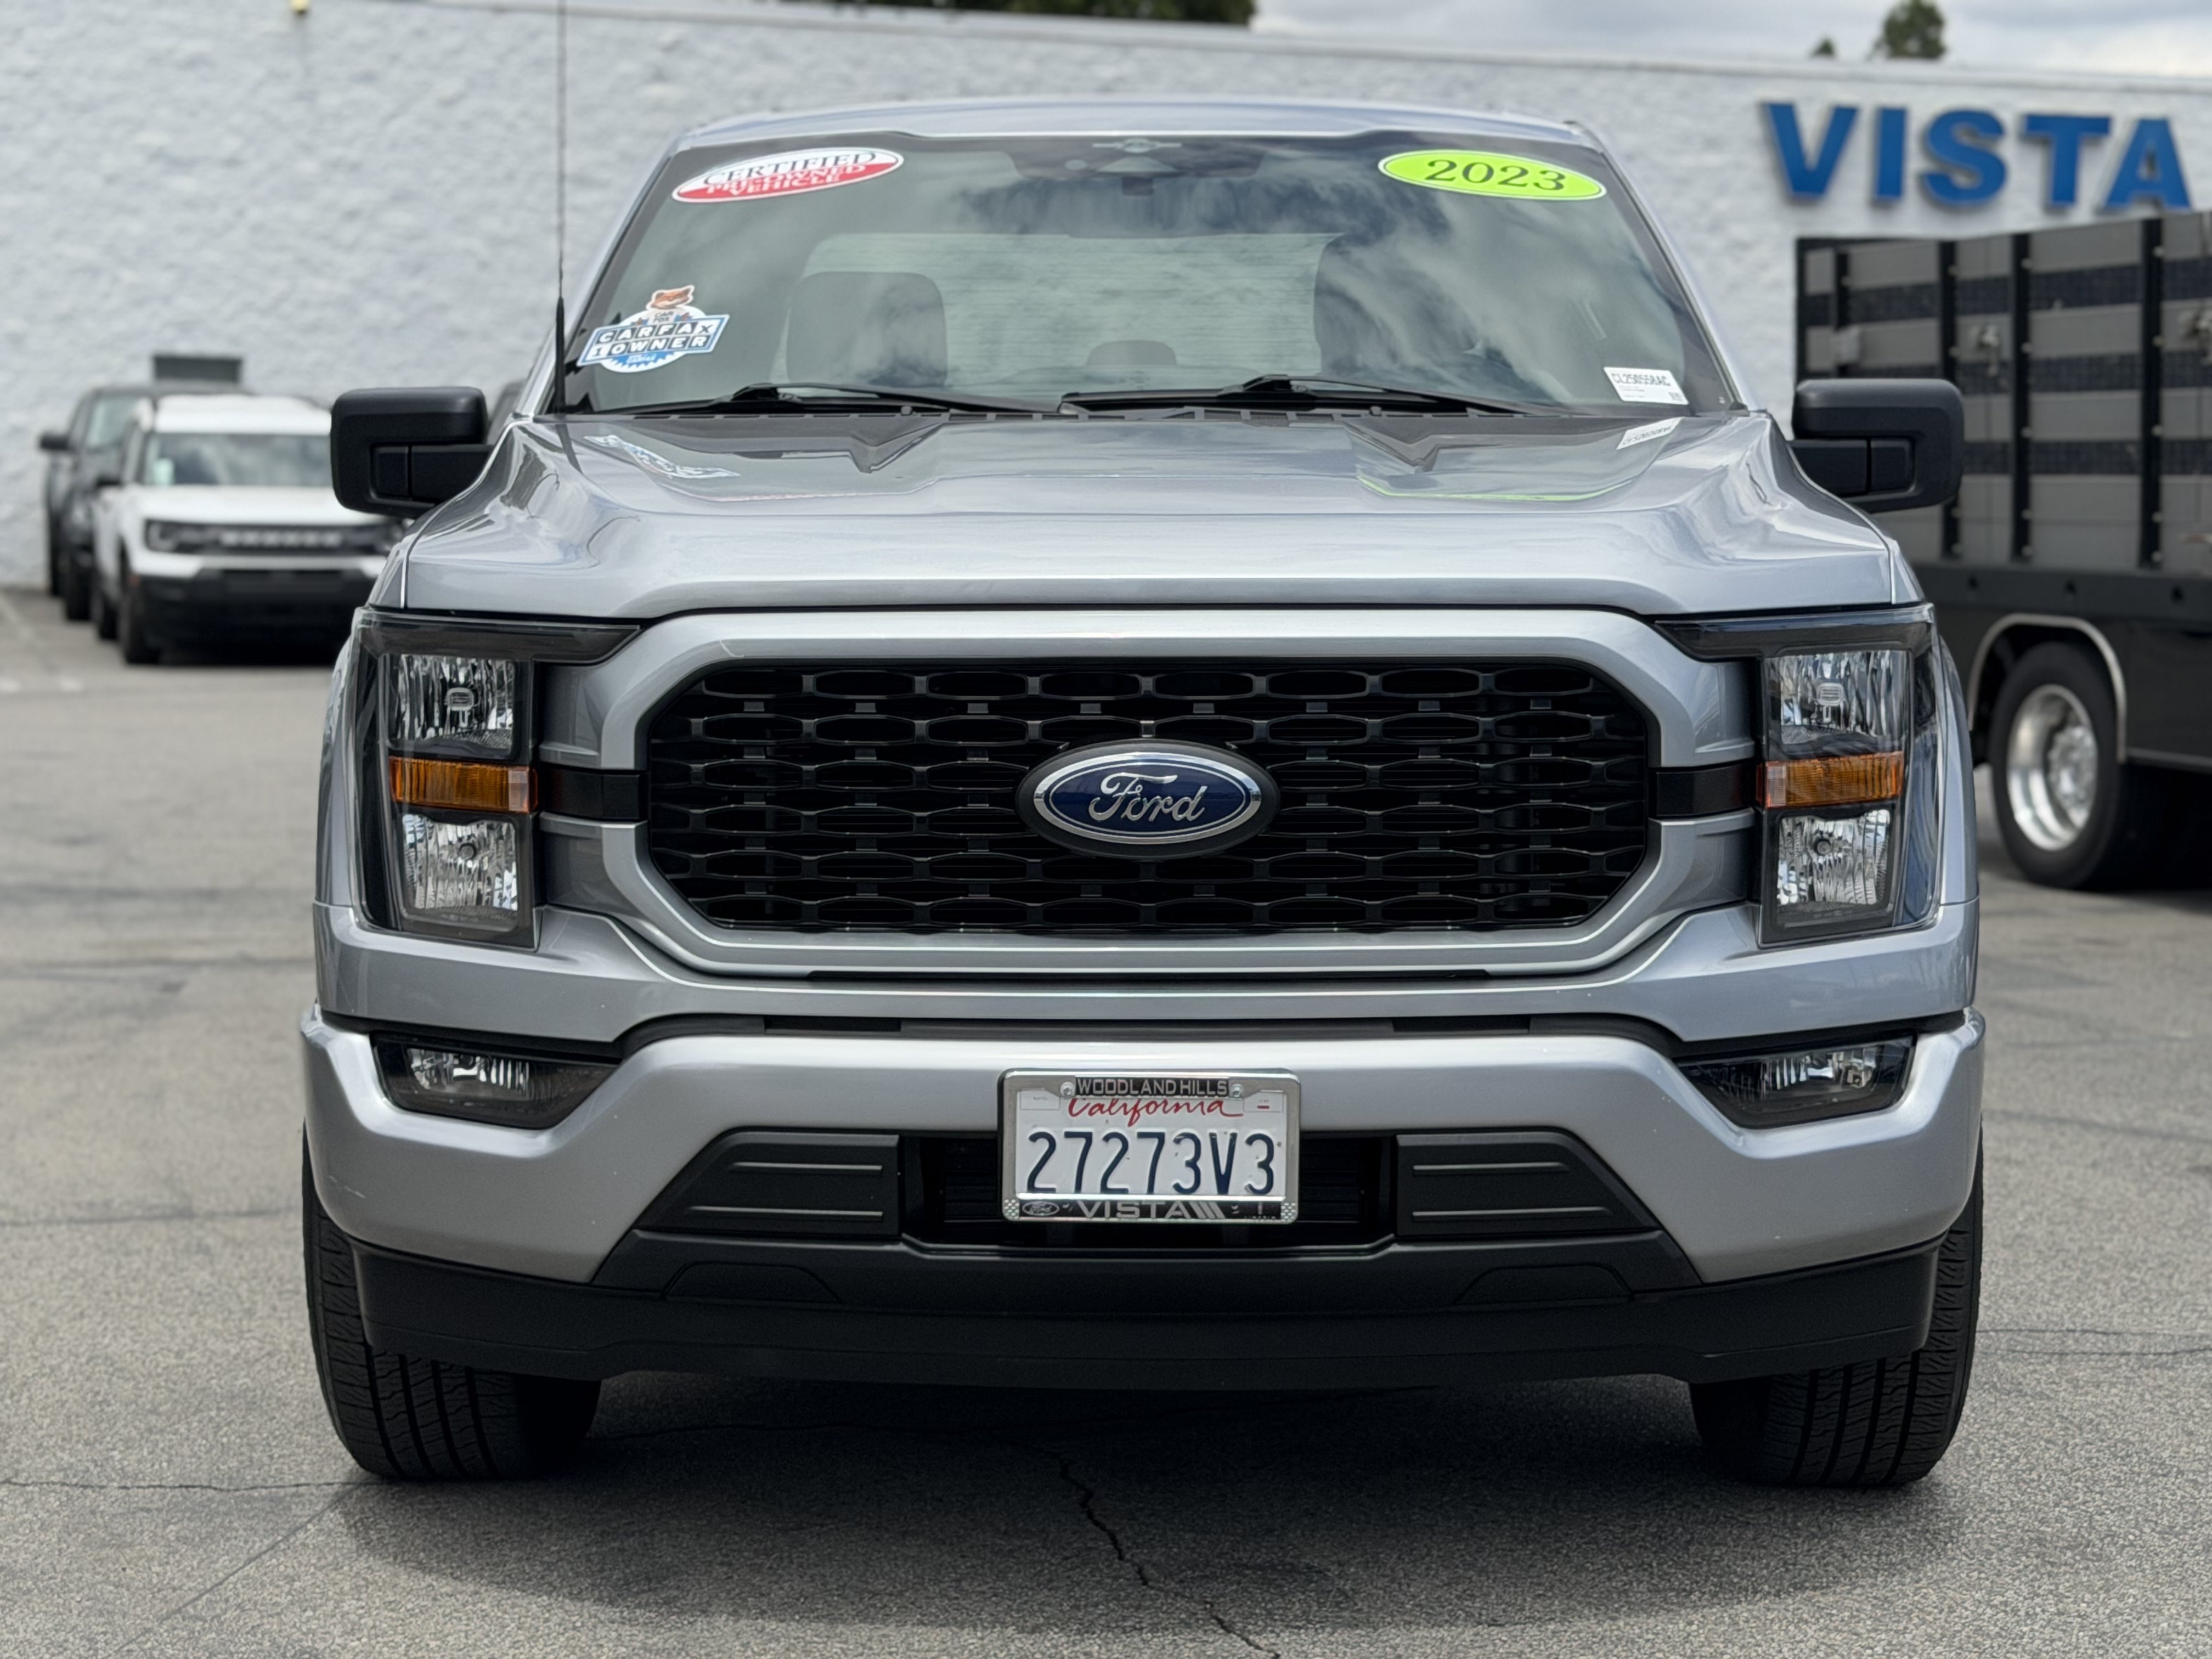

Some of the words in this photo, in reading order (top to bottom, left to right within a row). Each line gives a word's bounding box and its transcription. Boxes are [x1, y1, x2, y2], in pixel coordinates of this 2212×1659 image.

[703, 153, 876, 185] CERTIFIED
[1762, 103, 2192, 209] VISTA
[730, 174, 840, 195] VEHICLE
[1425, 160, 1566, 190] 2023
[599, 323, 713, 343] CARFAX
[611, 336, 707, 355] OWNER
[1088, 772, 1208, 822] Ford
[1077, 1079, 1177, 1094] WOODLAND
[1181, 1080, 1227, 1095] HILLS
[1068, 1097, 1244, 1127] California
[1027, 1131, 1274, 1195] 27273V3
[1077, 1200, 1192, 1219] VISTA
